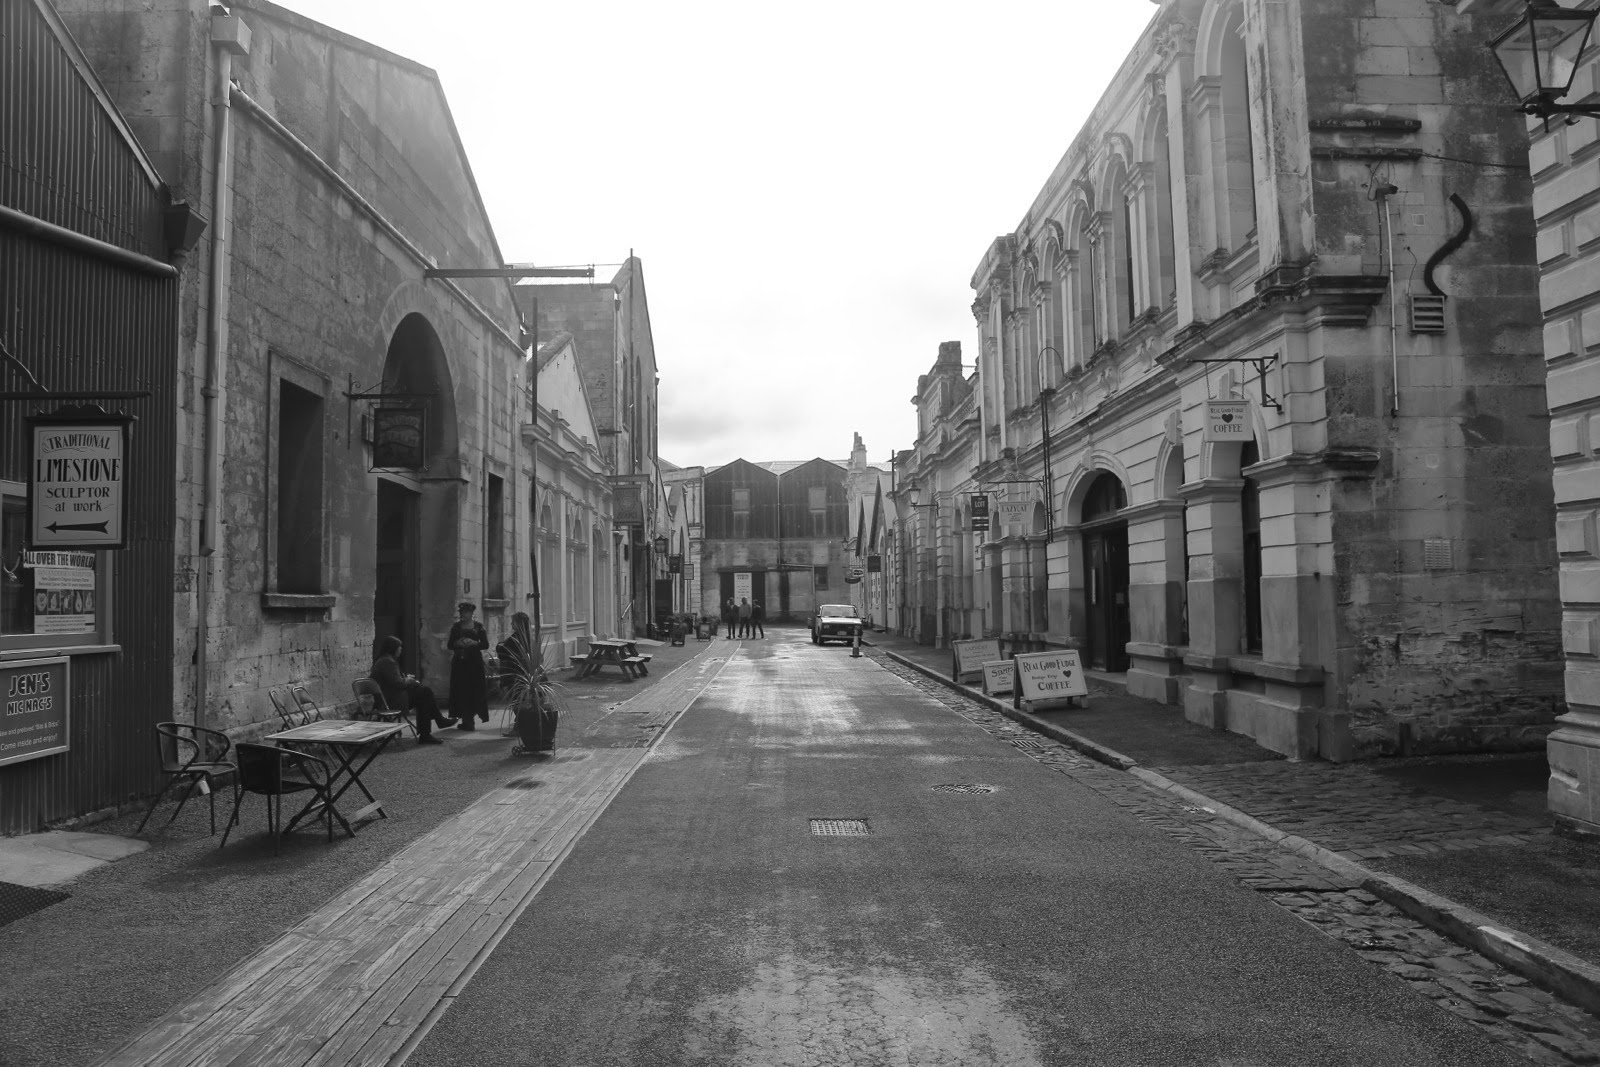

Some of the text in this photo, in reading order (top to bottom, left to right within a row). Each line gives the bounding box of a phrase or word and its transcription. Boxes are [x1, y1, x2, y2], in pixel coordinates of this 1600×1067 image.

[1214, 424, 1243, 433] COFFEE
[47, 433, 111, 450] TRADITIONAL
[36, 458, 121, 483] LIMESTONE
[46, 487, 110, 499] SCULPTOR
[55, 501, 102, 512] at work
[24, 551, 95, 568] ALL OVER THE WORLD
[1023, 659, 1076, 672] REAL GOOD FUDGE
[9, 672, 50, 697] JEN'S
[1038, 680, 1072, 690] COFFEE
[7, 696, 53, 716] NIC NAC'S
[0, 742, 16, 751] Come
[17, 739, 32, 747] inside
[33, 736, 42, 745] and
